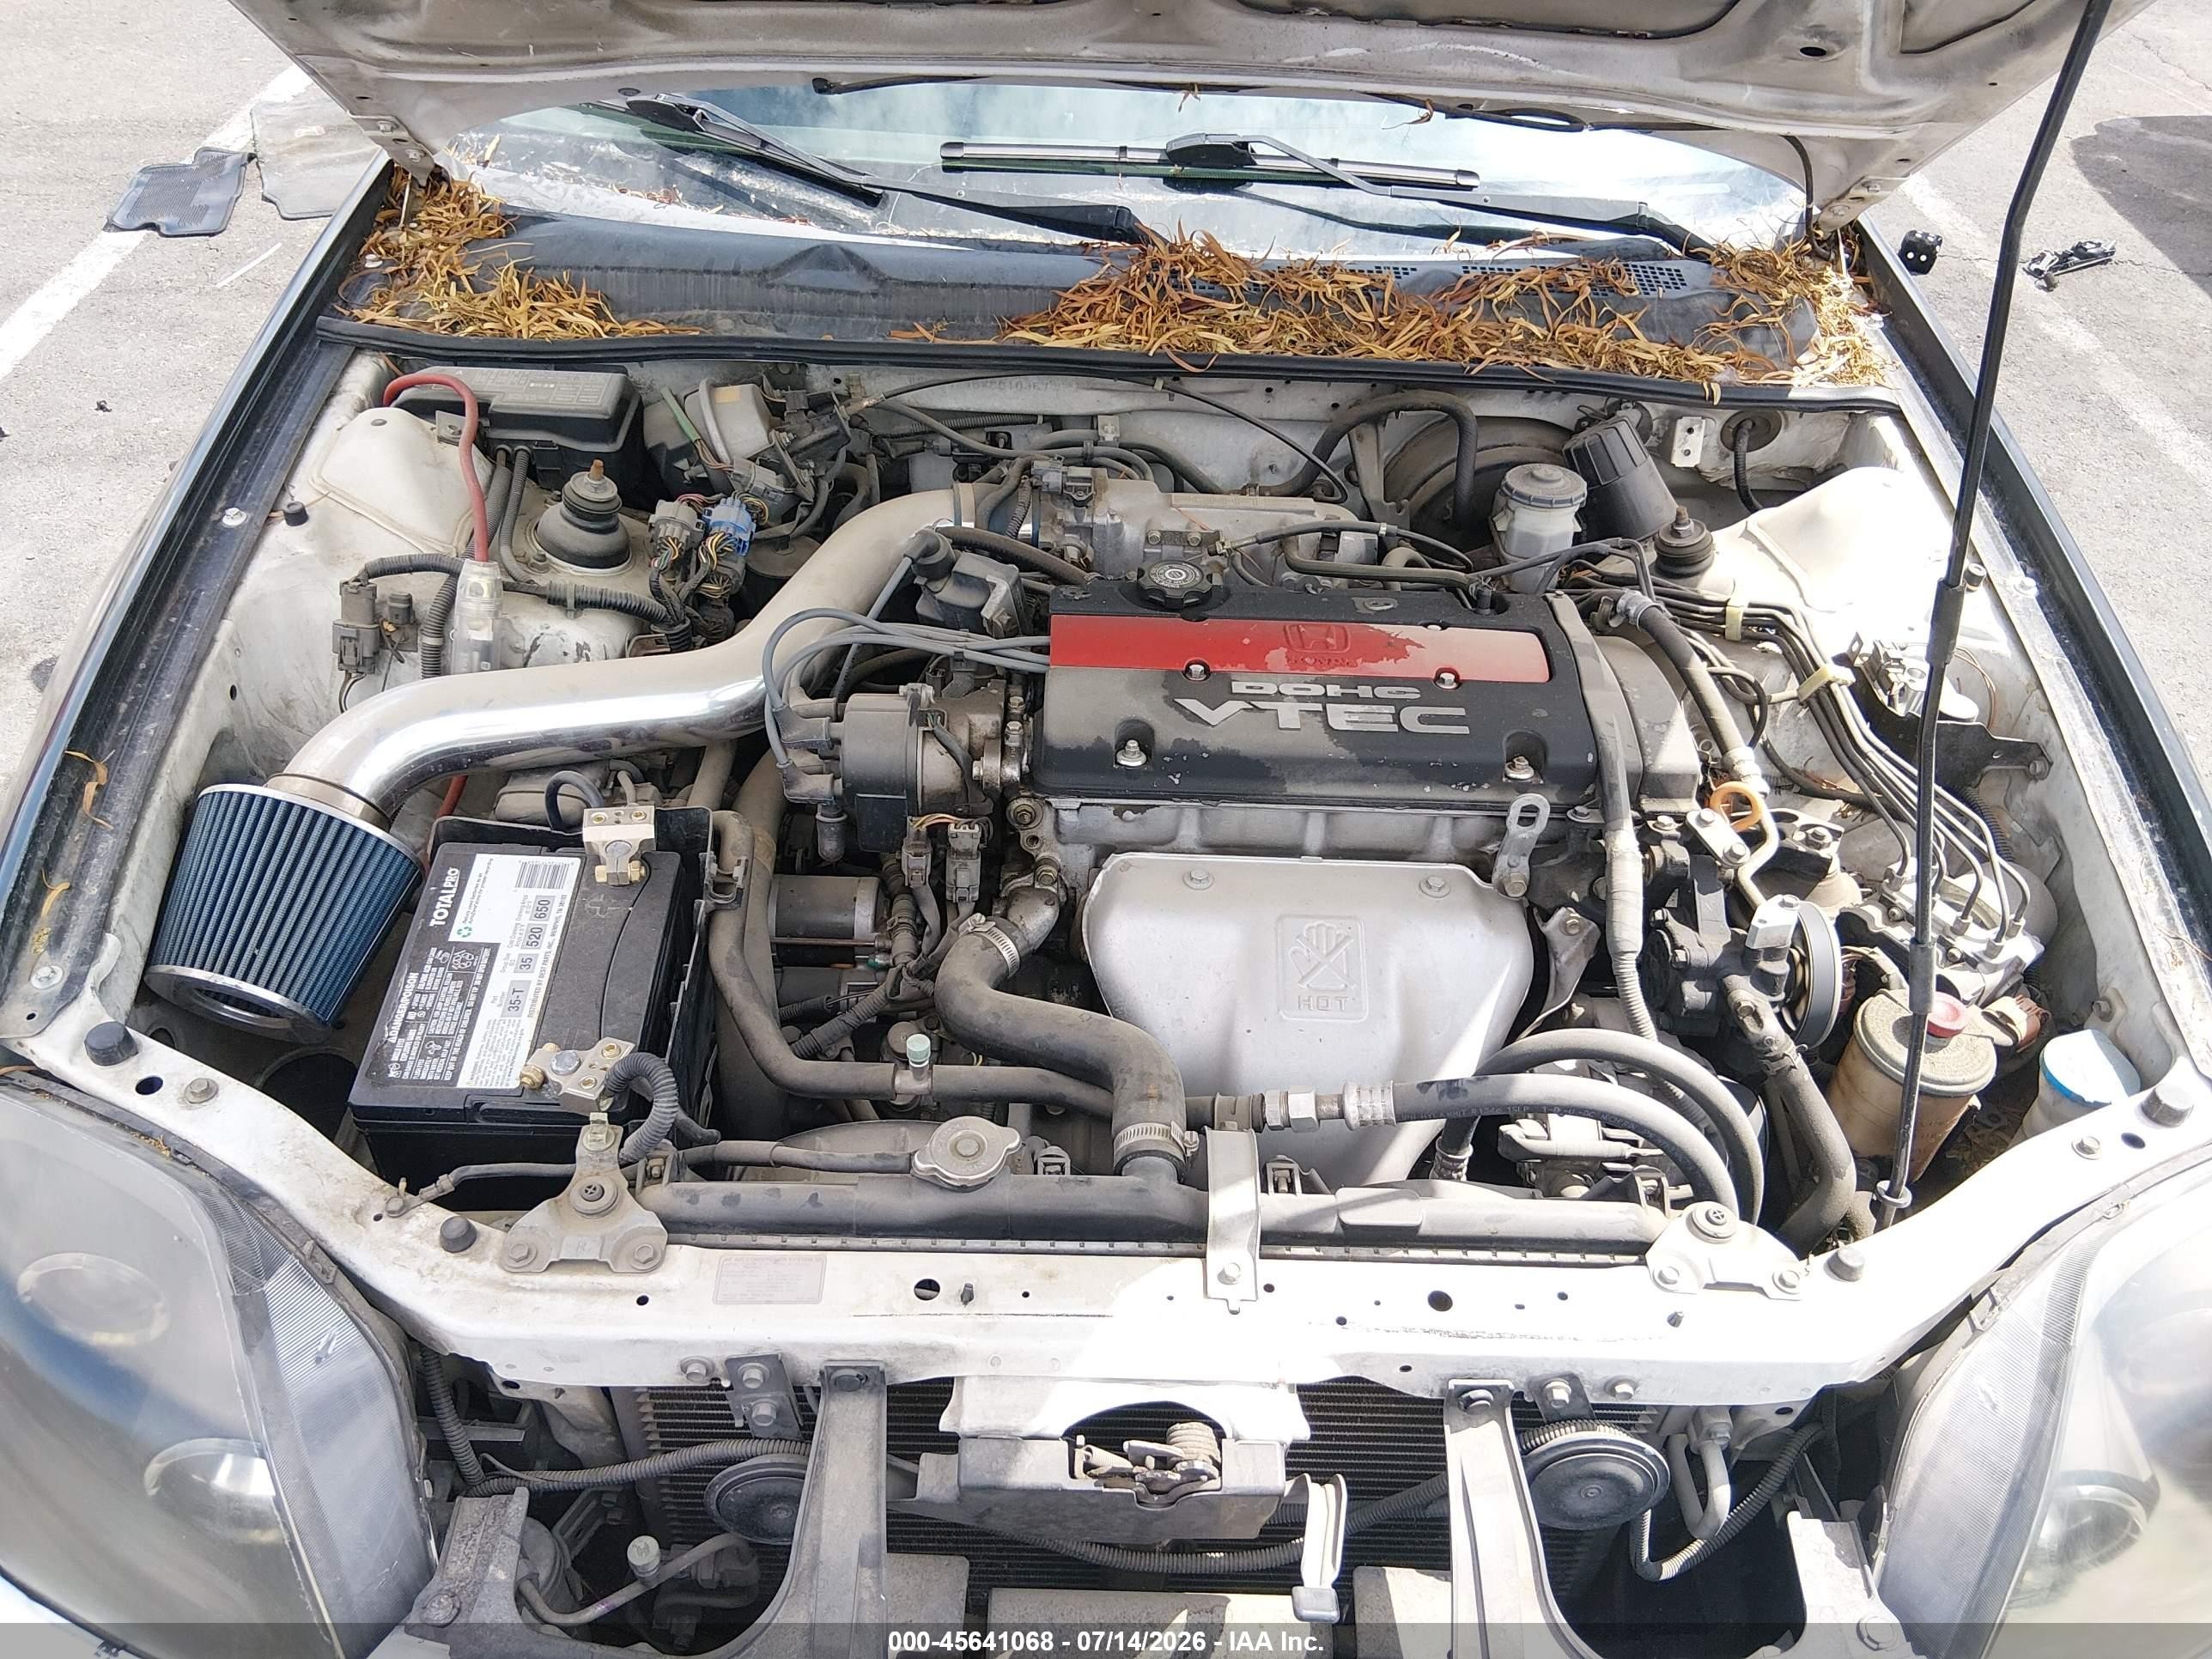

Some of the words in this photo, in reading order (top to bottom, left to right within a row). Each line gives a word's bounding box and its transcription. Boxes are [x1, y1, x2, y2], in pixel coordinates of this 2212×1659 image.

[1231, 681, 1421, 700] DOHC
[1174, 698, 1470, 735] VTEC
[430, 867, 460, 927] TOTALPRO
[533, 899, 550, 919] 650
[526, 927, 543, 946] 520
[519, 957, 532, 970] 35
[507, 988, 524, 1012] 35-T
[1297, 994, 1349, 1012] HOT
